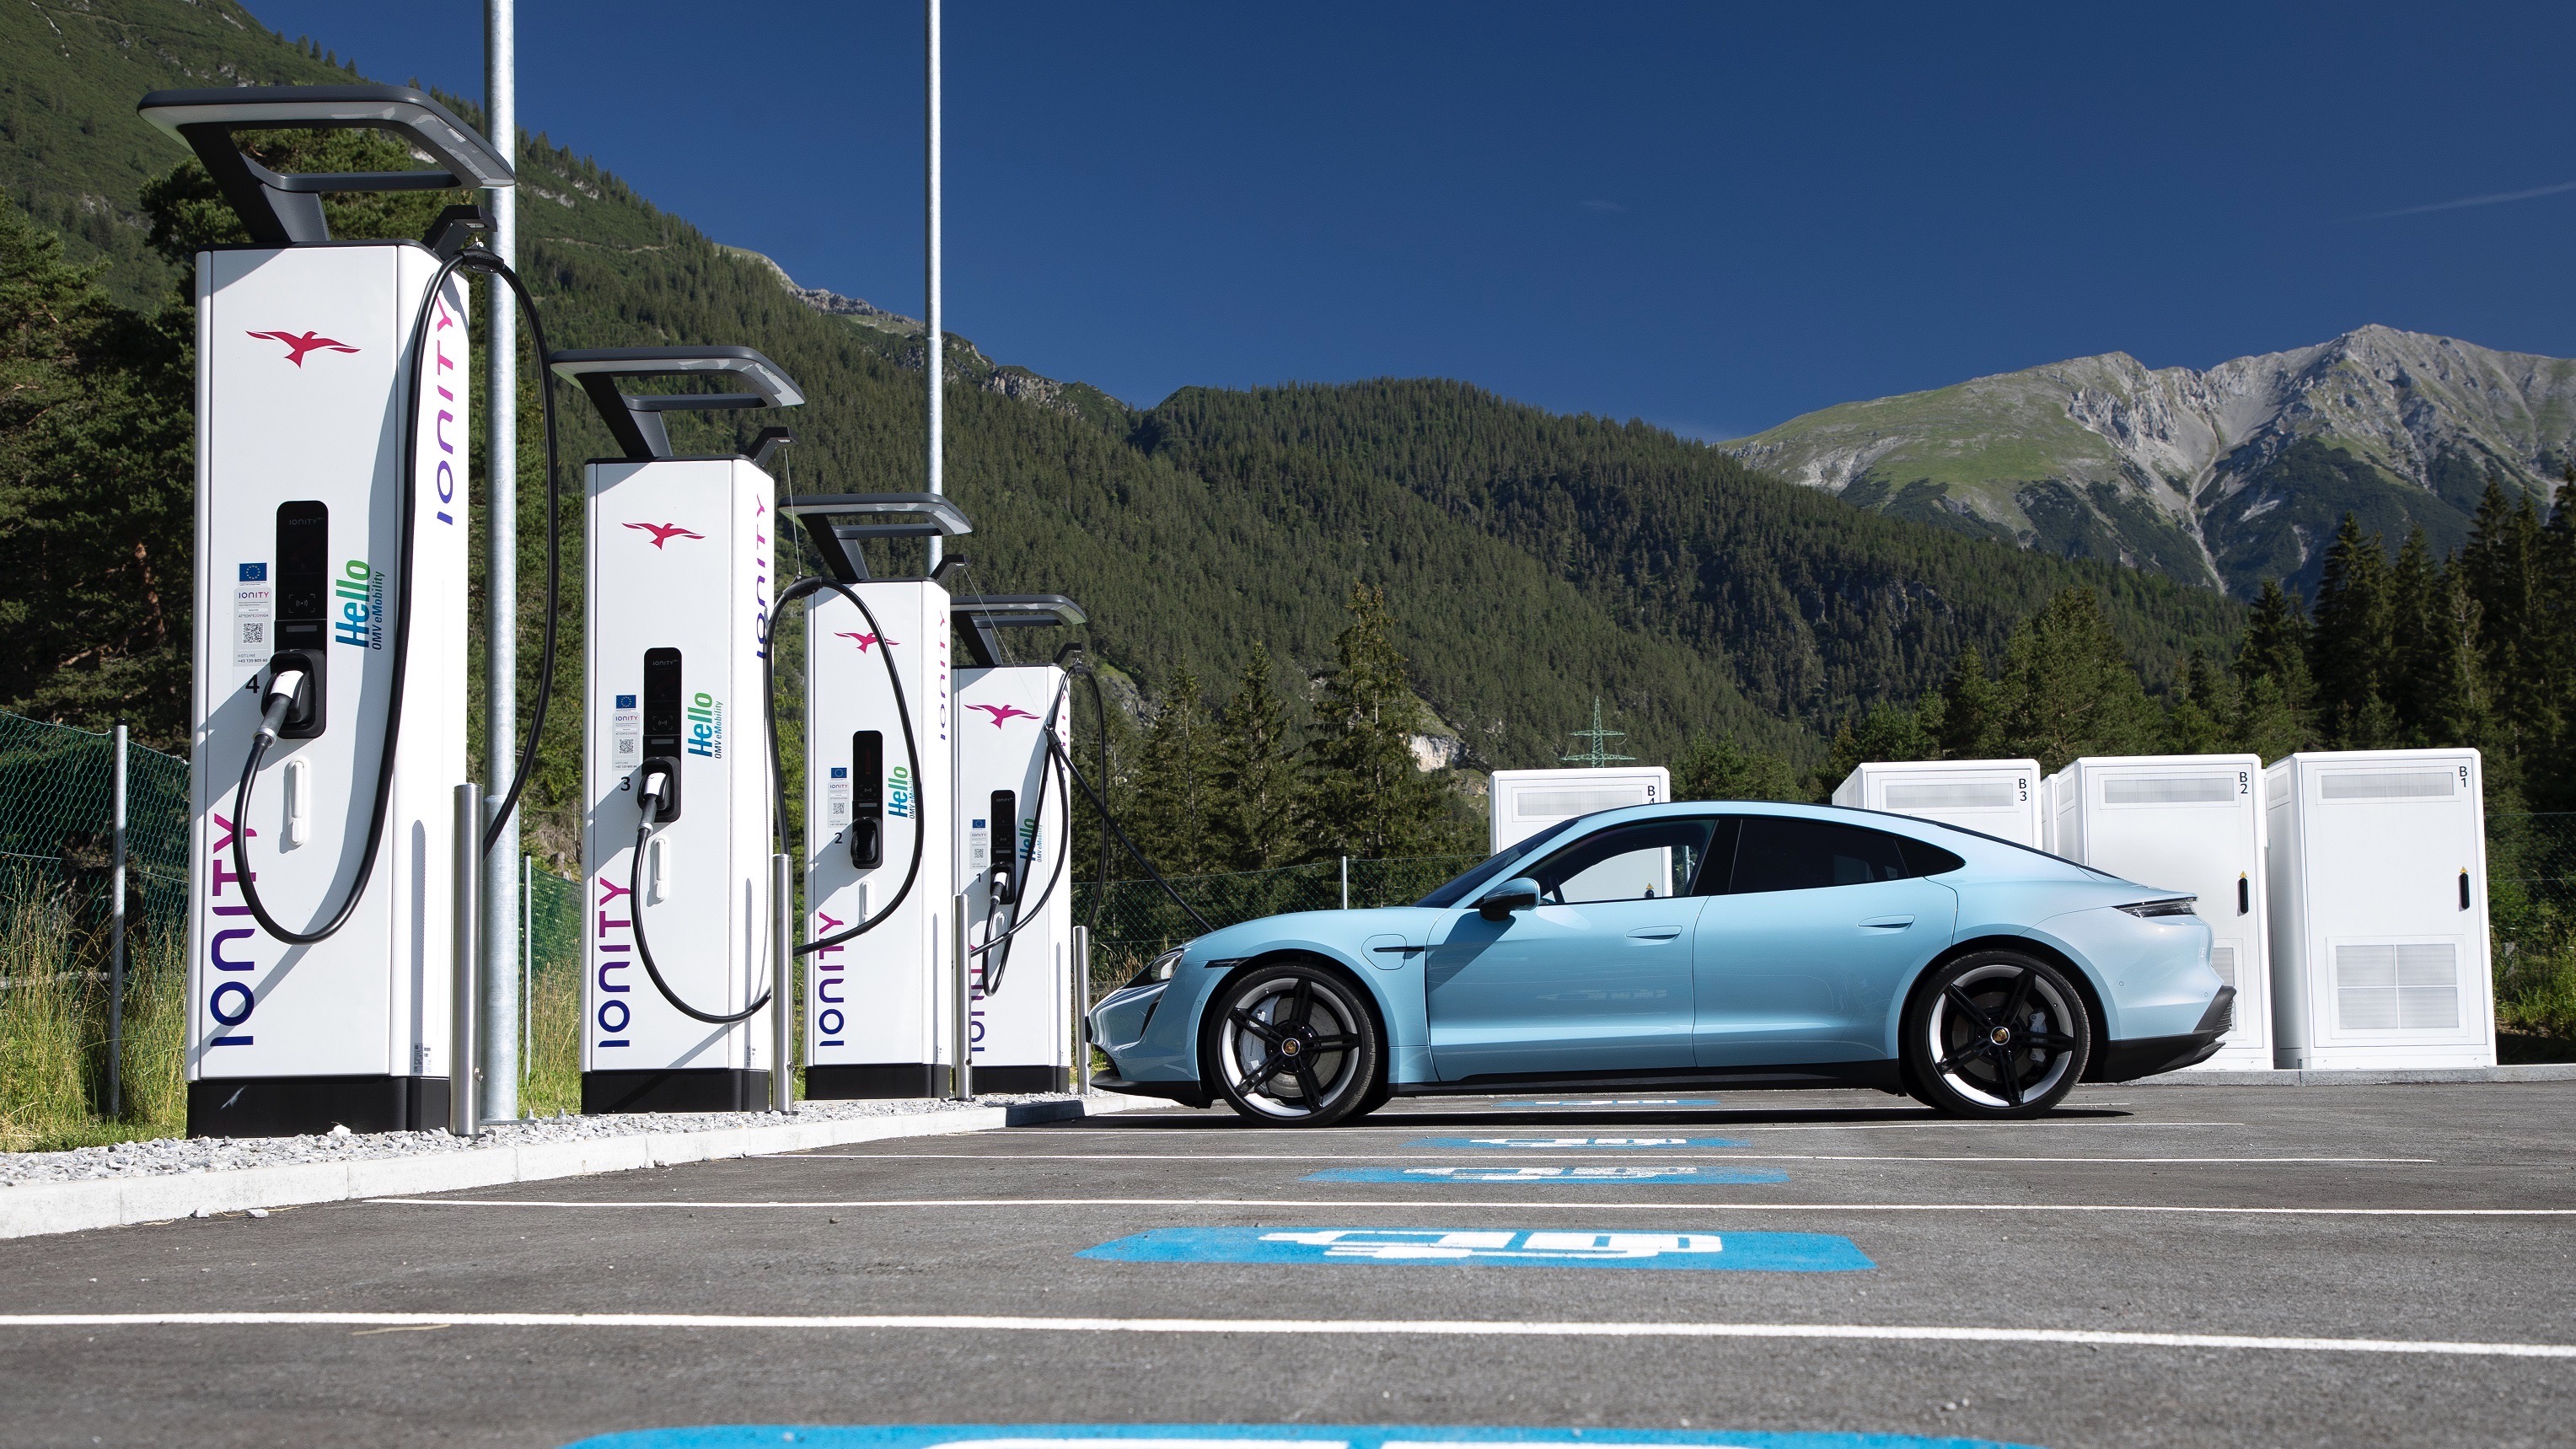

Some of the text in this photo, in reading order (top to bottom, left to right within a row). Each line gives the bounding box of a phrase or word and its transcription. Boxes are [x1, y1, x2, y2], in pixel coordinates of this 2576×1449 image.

[437, 295, 453, 526] IONITY
[239, 591, 270, 599] IONITY
[335, 560, 371, 648] Hello
[756, 493, 766, 659] IONITY
[371, 571, 385, 651] OMV eMobility
[245, 674, 260, 694] 4
[687, 692, 713, 758] Hello
[713, 700, 723, 759] OMV eMobility
[620, 776, 631, 792] 3
[888, 765, 909, 818] Hello
[1647, 785, 1656, 797] B
[834, 832, 843, 844] 2
[976, 872, 981, 883] 1
[209, 812, 258, 1047] IONITY
[598, 877, 631, 1048] IONITY
[818, 911, 845, 1047] IONITY
